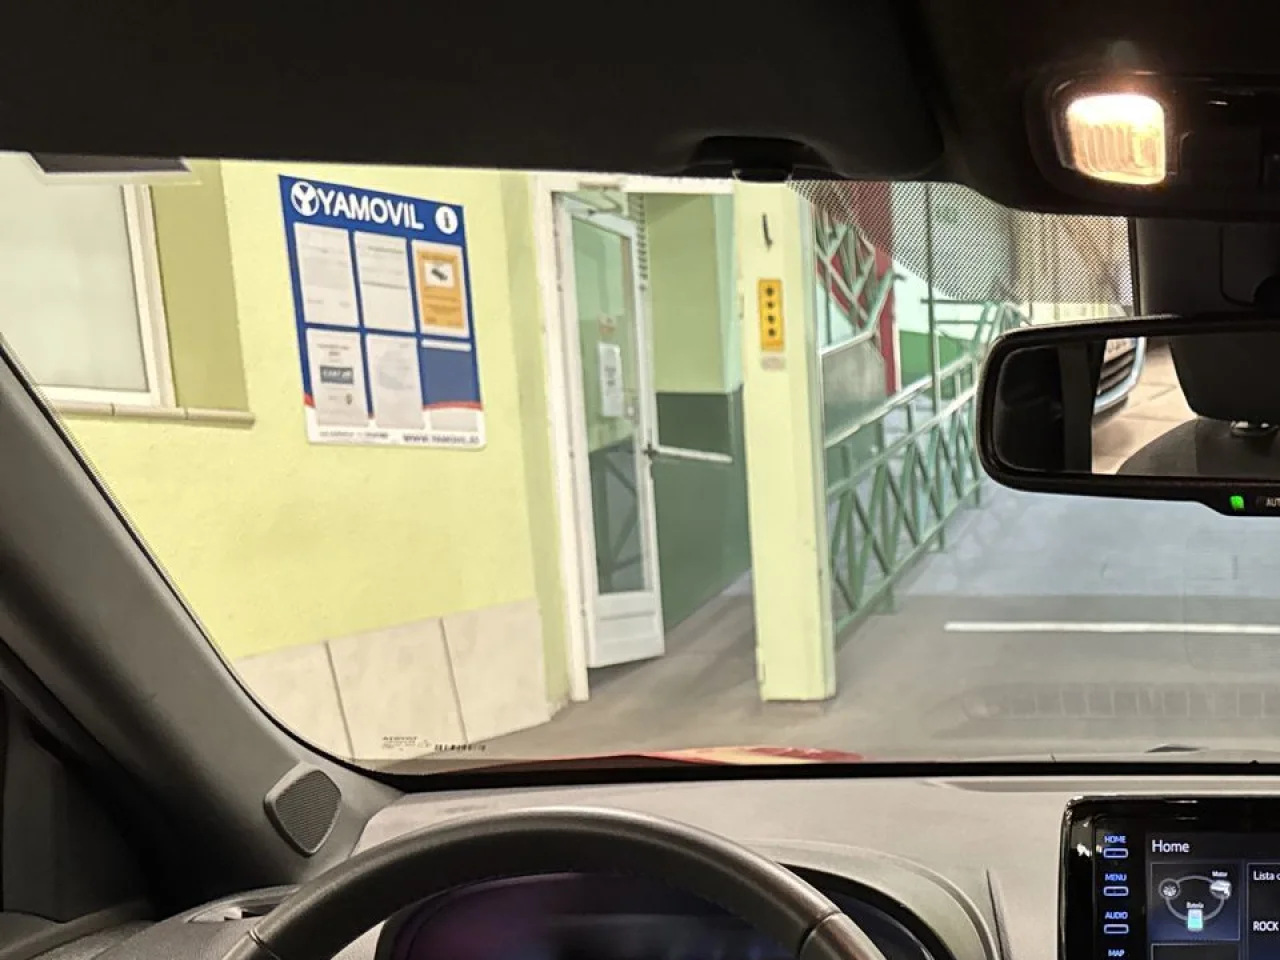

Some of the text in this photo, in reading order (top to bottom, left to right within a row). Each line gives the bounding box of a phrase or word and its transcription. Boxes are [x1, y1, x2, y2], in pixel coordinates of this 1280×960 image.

[317, 188, 425, 230] YAMOVIL
[1152, 840, 1190, 853] Home
[1253, 871, 1274, 881] Lista
[1105, 911, 1128, 919] AUDIO
[1253, 921, 1279, 931] ROCK
[1108, 949, 1125, 957] MAP
